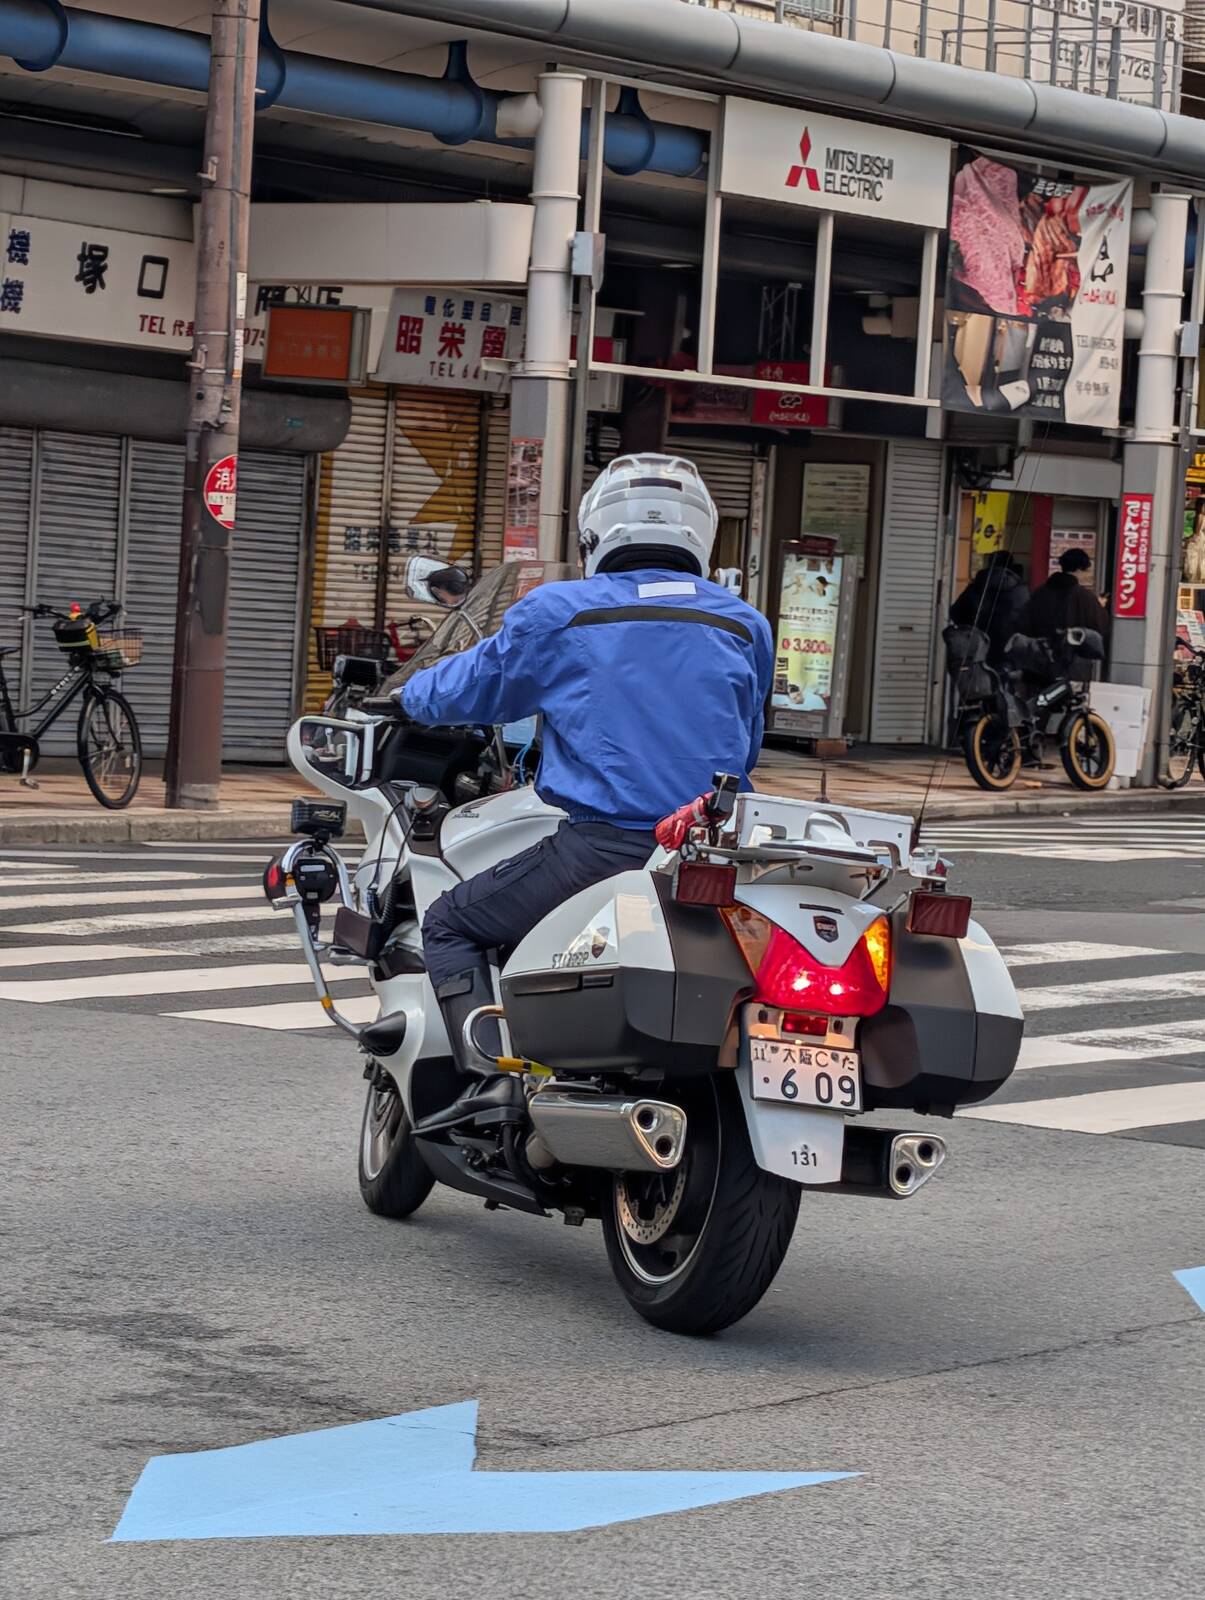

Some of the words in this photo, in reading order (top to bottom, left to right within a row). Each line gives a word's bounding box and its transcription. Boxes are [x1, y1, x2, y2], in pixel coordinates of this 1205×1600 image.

[826, 147, 894, 180] MITSUBISHI
[824, 171, 883, 202] ELECTRIC
[75, 241, 170, 300] 塚口
[139, 314, 165, 334] TEL
[429, 361, 456, 377] TEL
[1120, 501, 1140, 609] さんさんタウン
[791, 1150, 818, 1167] 131
